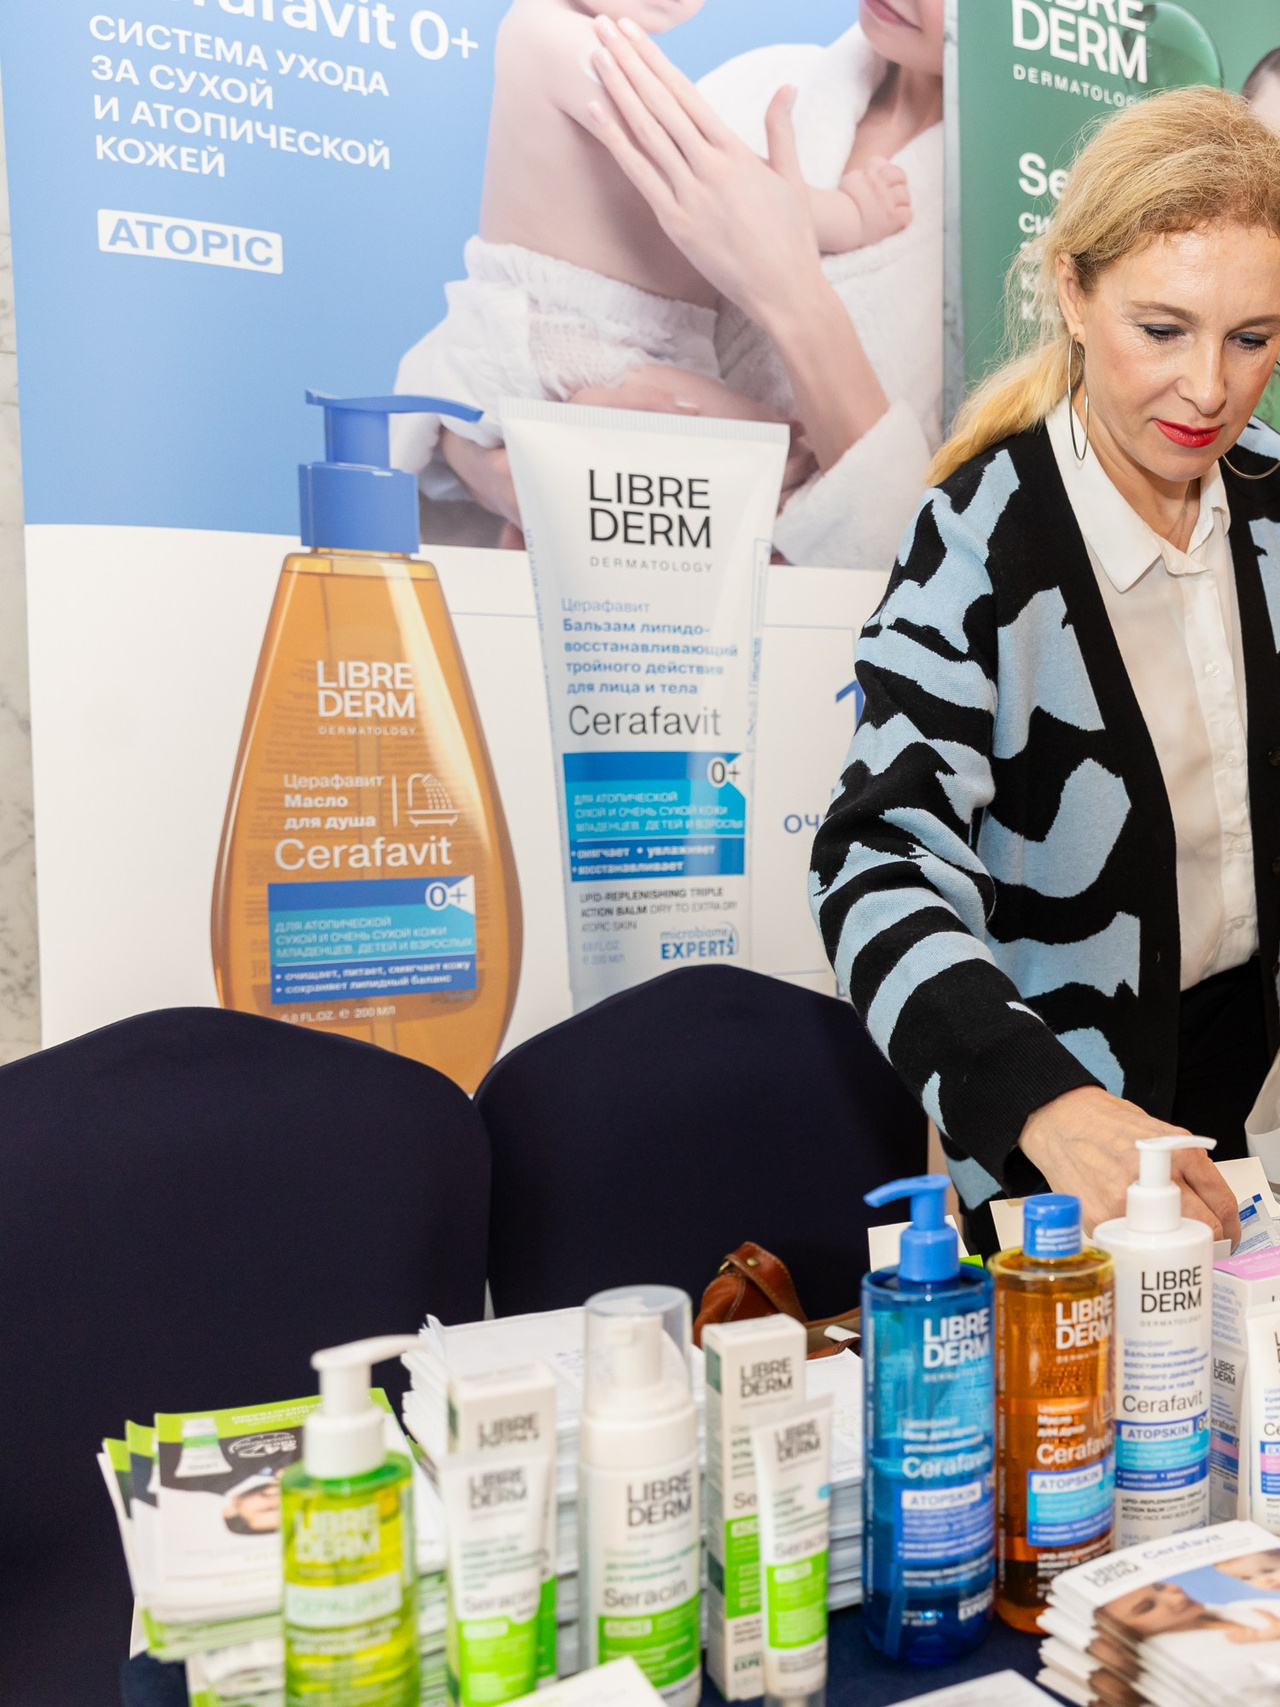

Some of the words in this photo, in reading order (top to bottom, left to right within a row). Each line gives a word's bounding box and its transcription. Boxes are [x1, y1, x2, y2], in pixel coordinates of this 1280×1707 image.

[410, 10, 479, 60] 0+
[1011, 1, 1148, 84] DERM
[89, 15, 269, 71] СИСТЕМА
[276, 50, 389, 96] УХОДА
[91, 55, 140, 86] ЗА
[149, 64, 273, 109] СУХОЙ
[93, 95, 119, 122] И
[131, 101, 390, 169] АТОПИЧЕСКОЙ
[95, 135, 226, 177] КОЖЕЙ
[107, 217, 275, 267] ATOPIC
[588, 469, 711, 509] LIBRE
[589, 507, 711, 550] DERM
[589, 556, 713, 573] DERMATOLOGY
[561, 598, 650, 614] Церафавит
[562, 618, 636, 633] Бальзам
[639, 621, 710, 636] липидо-
[564, 640, 738, 657] восстанавливающий
[316, 660, 415, 689] LIBRE
[566, 660, 641, 676] тройного
[645, 662, 724, 676] действия
[567, 681, 595, 695] для
[599, 681, 640, 695] лица
[645, 683, 656, 693] и
[660, 682, 698, 694] тела
[317, 690, 416, 719] DERM
[318, 725, 417, 736] DERMATOLOGY
[568, 705, 722, 736] Cerafavit
[283, 774, 384, 789] Церафавит
[710, 761, 741, 785] 0+
[284, 794, 349, 809] Масло
[284, 816, 322, 830] для
[325, 813, 376, 829] душа
[274, 835, 453, 871] Cerafavit
[428, 885, 468, 907] 0+
[1140, 1265, 1202, 1291] LIBRE
[1055, 1291, 1112, 1326] LIBRE
[1140, 1288, 1202, 1314] DERM
[923, 1308, 990, 1343] LIBRE
[1055, 1316, 1112, 1350] DERM
[923, 1333, 990, 1369] DERM
[740, 1357, 792, 1382] LIBRE
[1213, 1358, 1236, 1375] LIBRE
[1213, 1369, 1237, 1386] DERM
[741, 1375, 793, 1399] DERM
[1122, 1390, 1203, 1414] Cerafavit
[774, 1419, 818, 1445] LIBRE
[1037, 1413, 1073, 1426] Масло
[1127, 1425, 1190, 1440] ATOPSKIN
[776, 1436, 822, 1463] DERM
[626, 1469, 692, 1503] LIBRE
[1039, 1471, 1100, 1490] ATOPSKIN
[627, 1494, 692, 1528] DERM
[910, 1488, 977, 1508] ATOPSKIN
